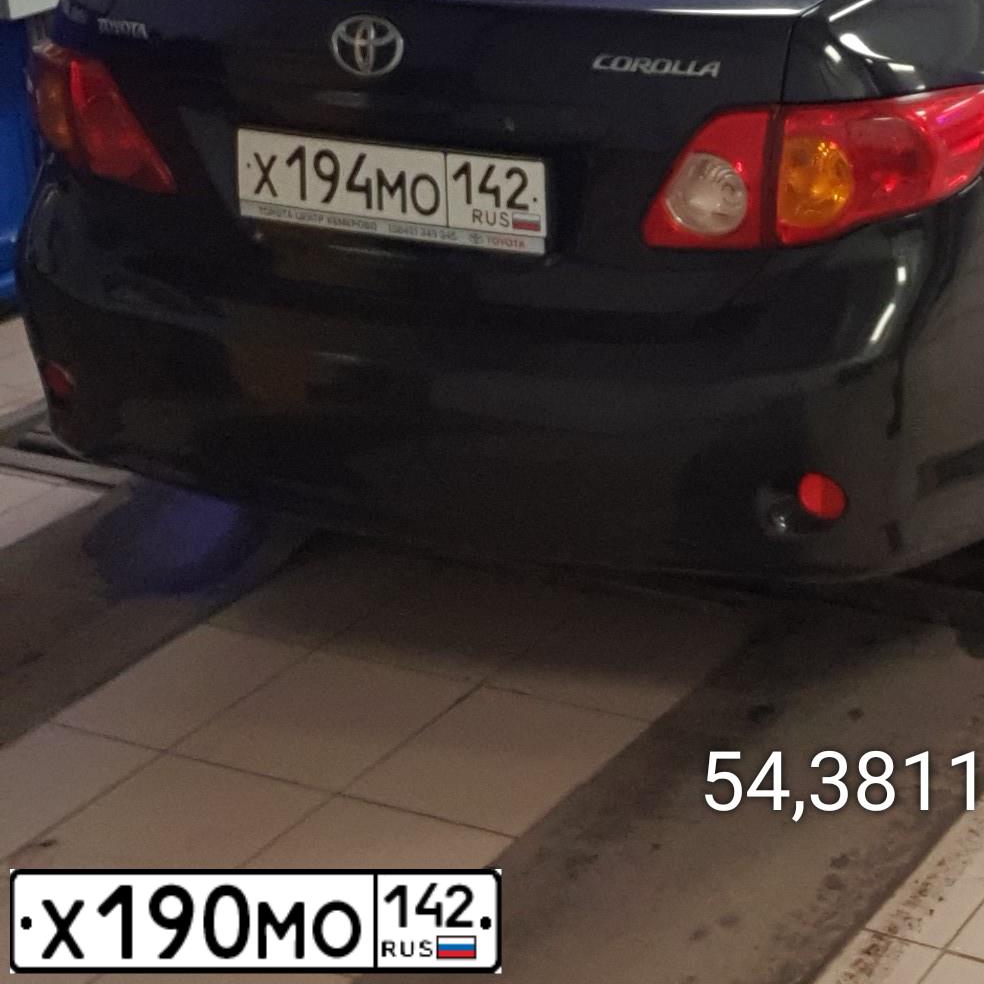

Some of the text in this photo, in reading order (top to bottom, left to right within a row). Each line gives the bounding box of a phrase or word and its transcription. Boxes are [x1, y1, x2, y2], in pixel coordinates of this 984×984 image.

[592, 53, 721, 78] COROLLA
[452, 161, 530, 211] 142
[471, 208, 510, 229] RUS
